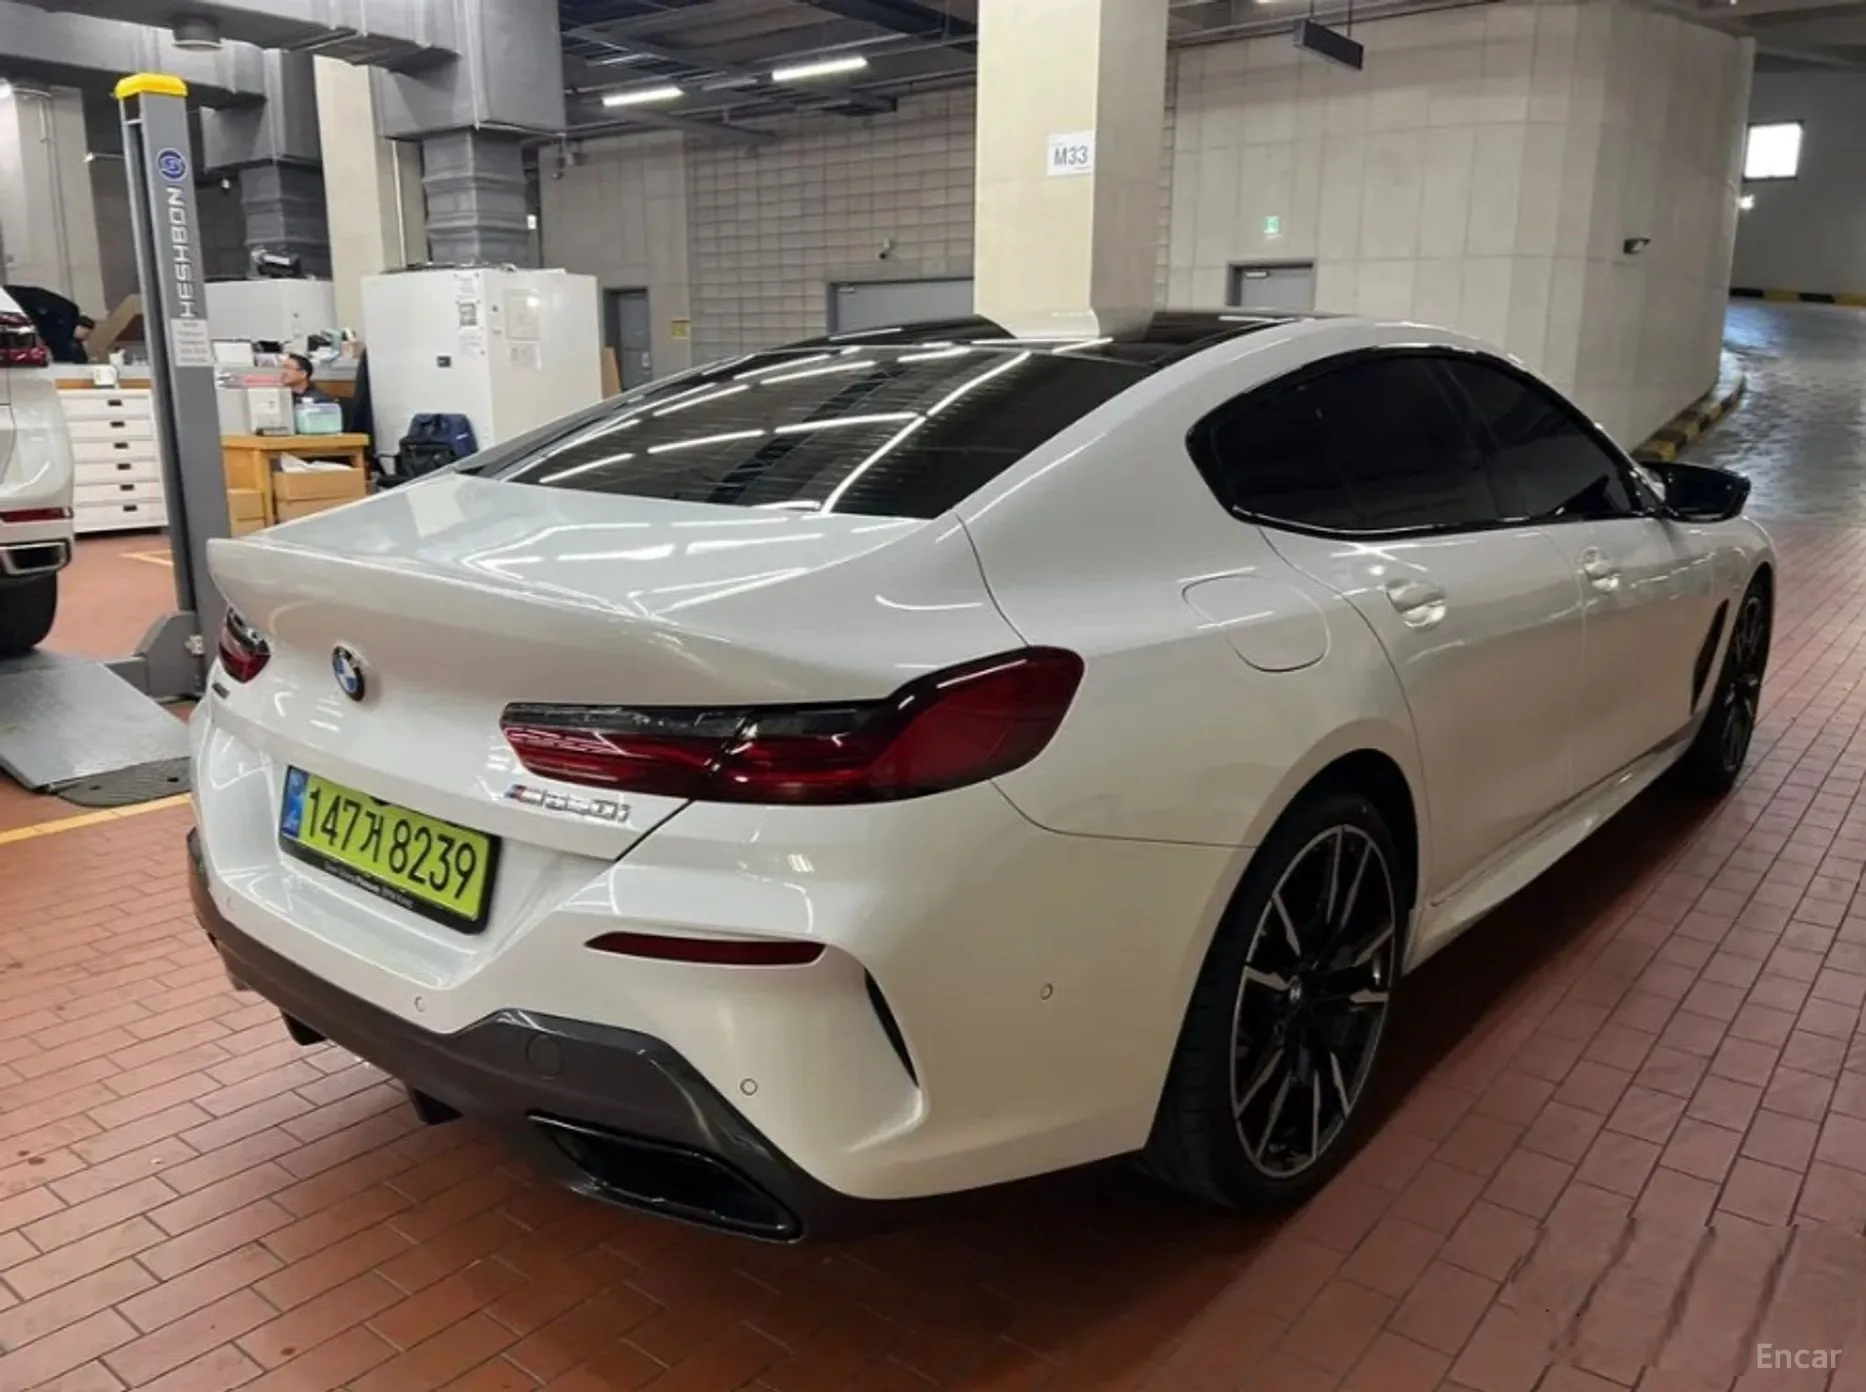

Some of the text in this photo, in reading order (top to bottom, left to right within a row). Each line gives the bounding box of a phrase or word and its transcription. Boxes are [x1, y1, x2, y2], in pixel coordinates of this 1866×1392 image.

[1053, 144, 1088, 166] M33
[166, 186, 196, 318] HESHBON
[309, 787, 384, 863] 147거
[388, 818, 477, 899] 8239
